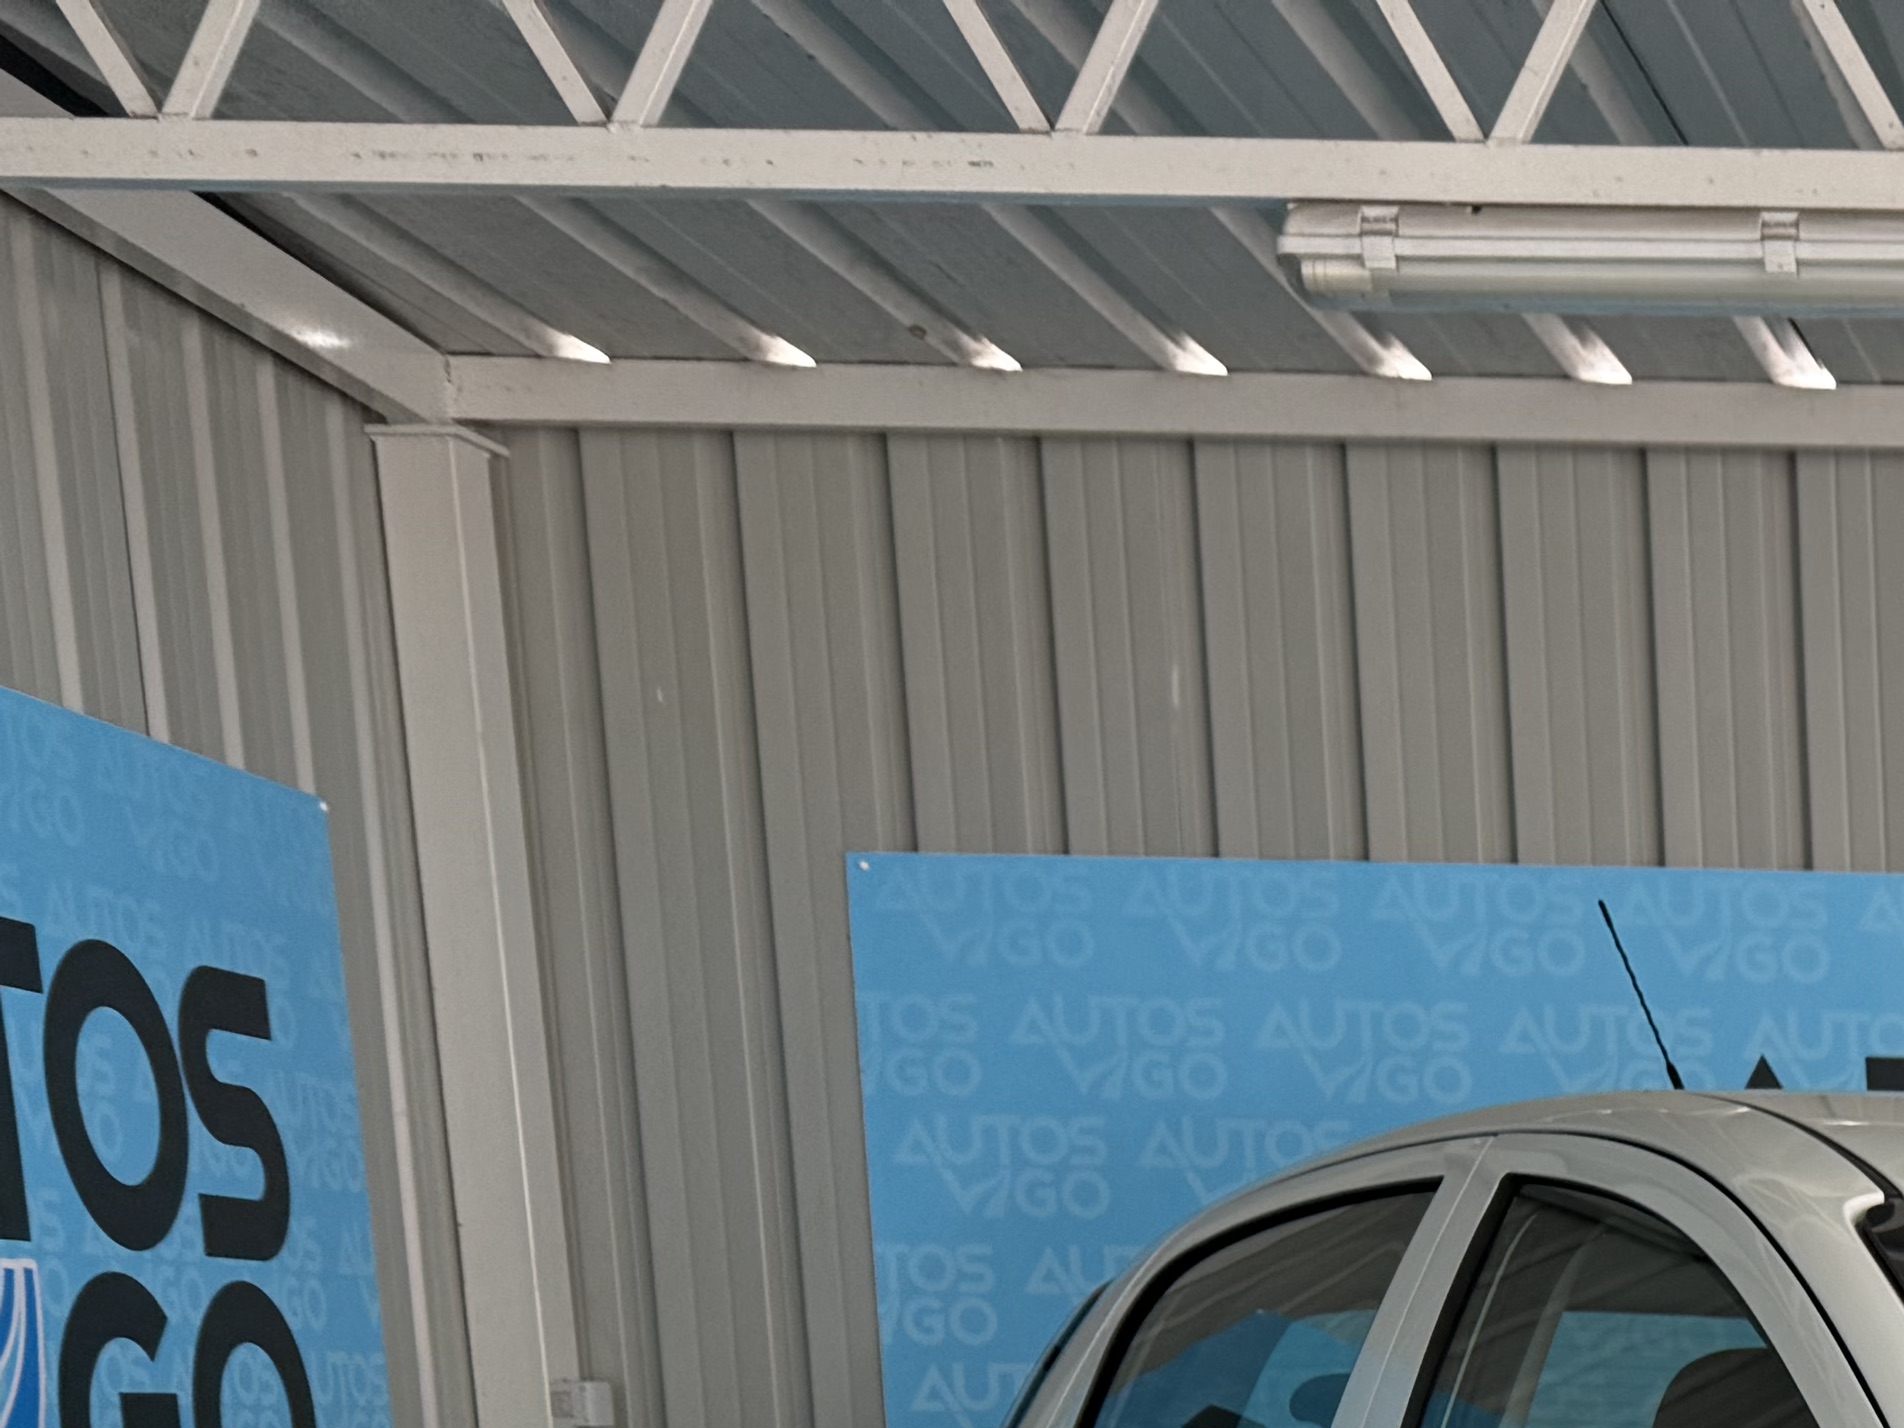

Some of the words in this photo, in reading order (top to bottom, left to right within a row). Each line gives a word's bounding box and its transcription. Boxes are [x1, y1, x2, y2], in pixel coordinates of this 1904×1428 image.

[874, 864, 1096, 914] AUTOS
[1122, 868, 1341, 919] AUTOS
[1369, 871, 1584, 925] AUTOS
[1614, 878, 1830, 931] AUTOS
[1008, 994, 1226, 1049] AUTOS
[1252, 998, 1472, 1051] AUTOS
[1502, 1001, 1714, 1056] AUTOS
[893, 1114, 1109, 1167] AUTOS
